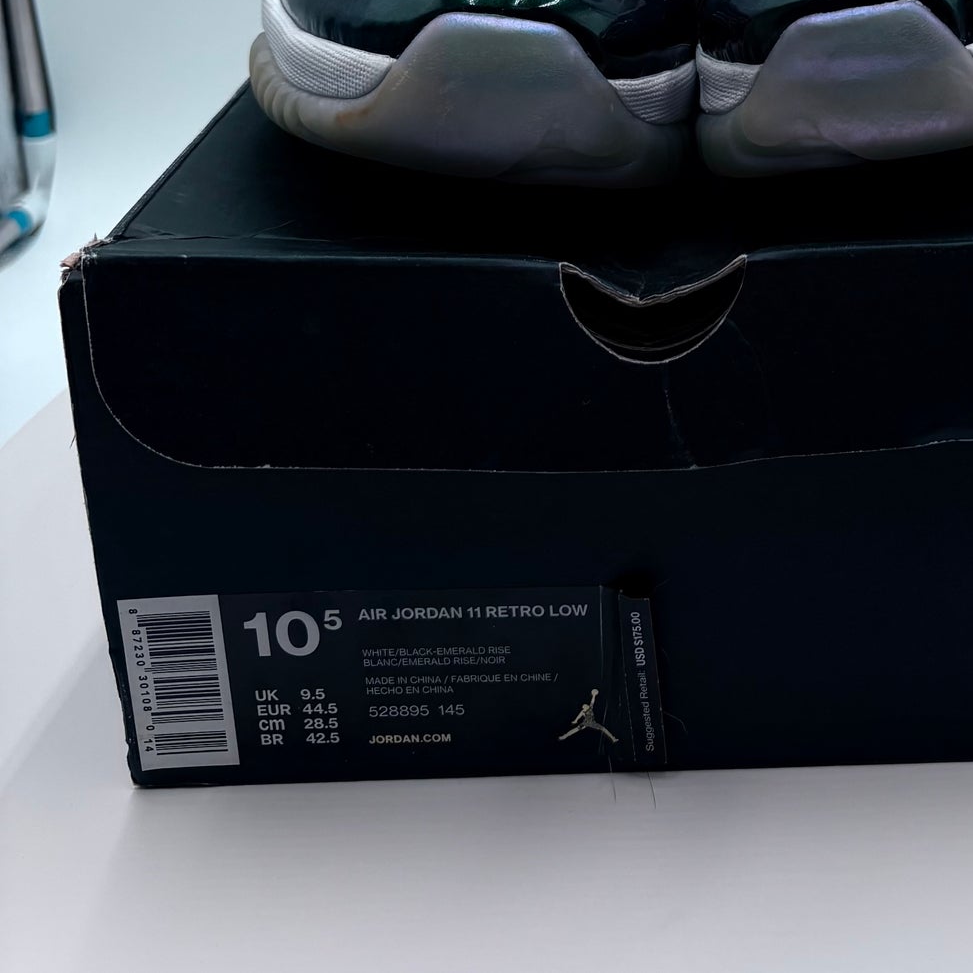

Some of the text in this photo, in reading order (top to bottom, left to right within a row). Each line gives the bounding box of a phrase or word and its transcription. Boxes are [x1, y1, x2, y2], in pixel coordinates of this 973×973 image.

[358, 604, 588, 621] AIR JORDAN 11 RETRO LOW
[131, 628, 146, 667] 87230
[362, 645, 511, 658] WHITE/BLACK-EMERALD RISE
[363, 655, 506, 667] BLANC/EMERALD RISE/NOIR
[635, 647, 646, 667] USD
[365, 676, 395, 685] MADE
[397, 676, 408, 684] IN
[410, 675, 442, 684] CHINA
[451, 674, 502, 684] FABRIQUE
[504, 673, 518, 682] EN
[520, 673, 552, 682] CHINE
[138, 674, 153, 713] 30108
[255, 688, 326, 702] UK 9.5
[366, 685, 454, 695] HECHO EN CHINA
[257, 703, 338, 716] EUR 44.5
[369, 704, 465, 718] 528895 145
[258, 717, 339, 731] cm 28.5
[640, 701, 655, 752] Suggested
[143, 738, 154, 753] 14
[260, 732, 340, 746] BR 42.5
[369, 733, 452, 745] JORDAN.COM
